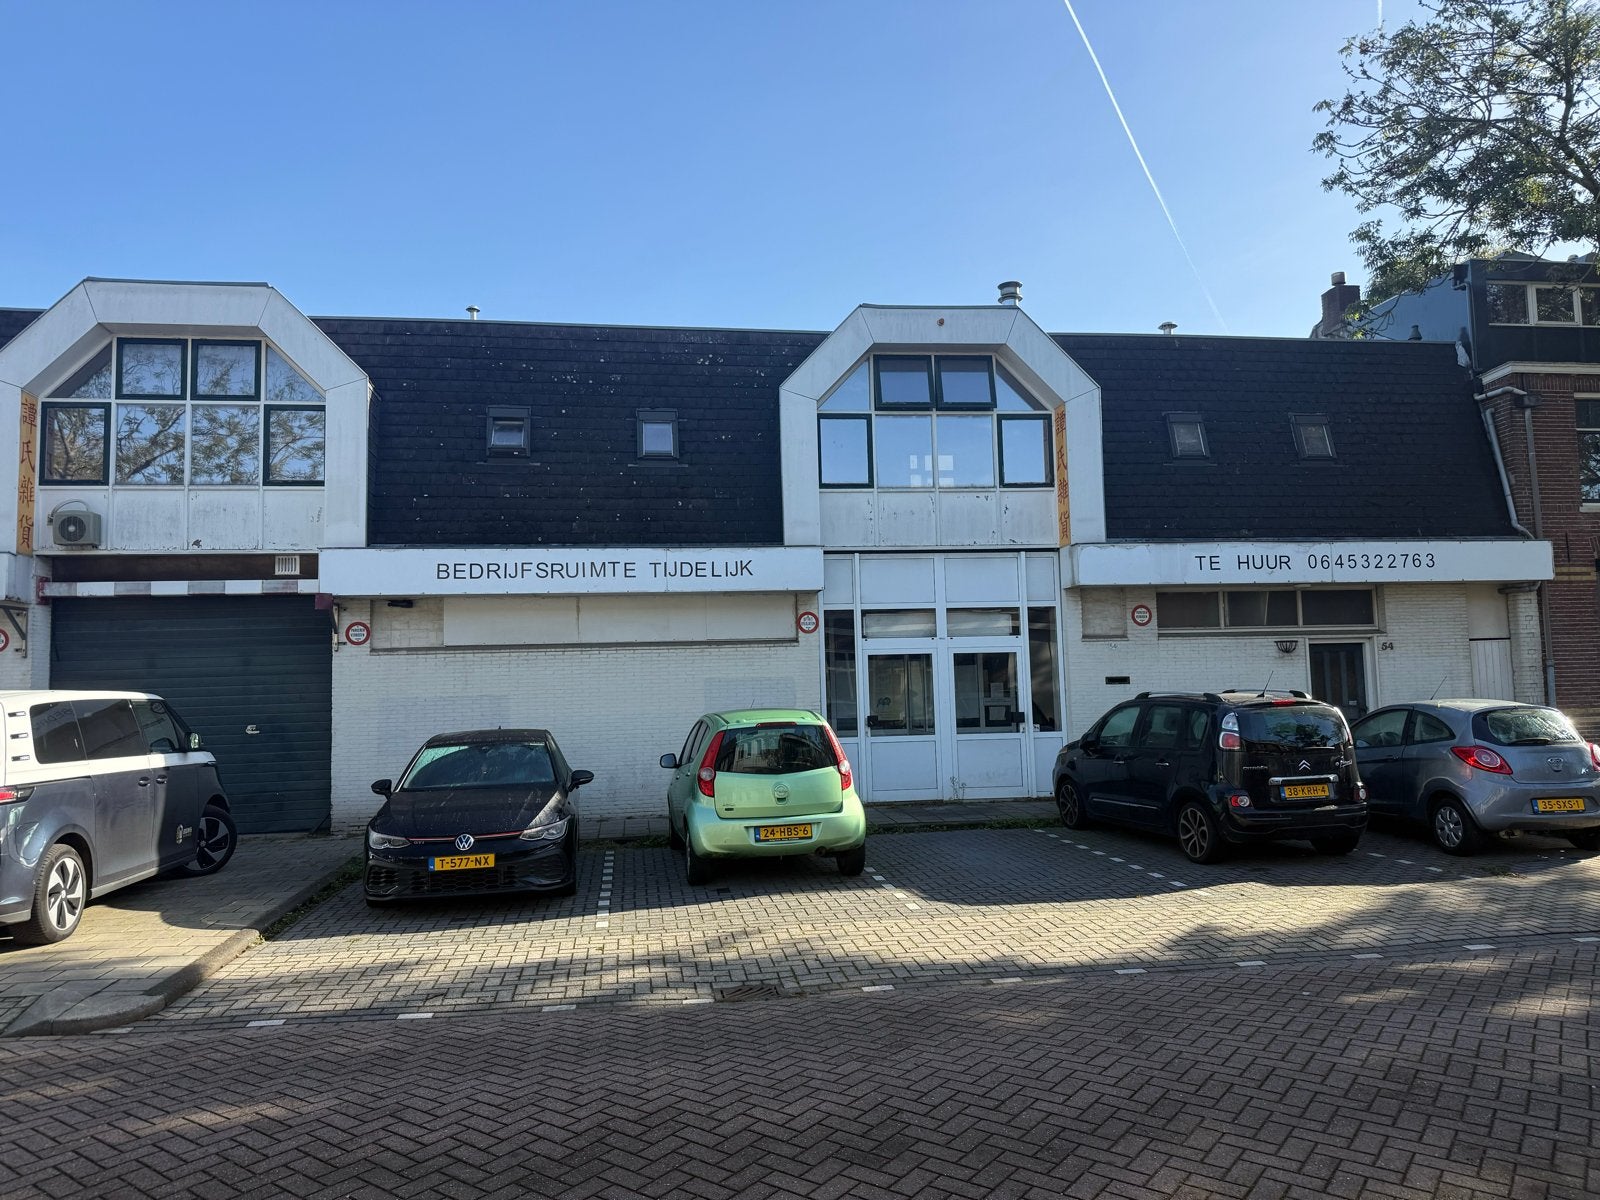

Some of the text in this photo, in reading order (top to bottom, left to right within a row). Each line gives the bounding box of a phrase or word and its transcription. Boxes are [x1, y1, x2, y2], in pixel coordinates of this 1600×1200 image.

[1195, 553, 1436, 571] TE HUUR 0645322763
[436, 560, 754, 580] BEDRIJFSRUIMTE TIJDELIJK
[1287, 785, 1326, 797] 38-KRH-4
[1541, 800, 1581, 810] 35-SXS-1
[763, 826, 809, 838] 24-HBS-6
[439, 856, 490, 869] T-577-NX
